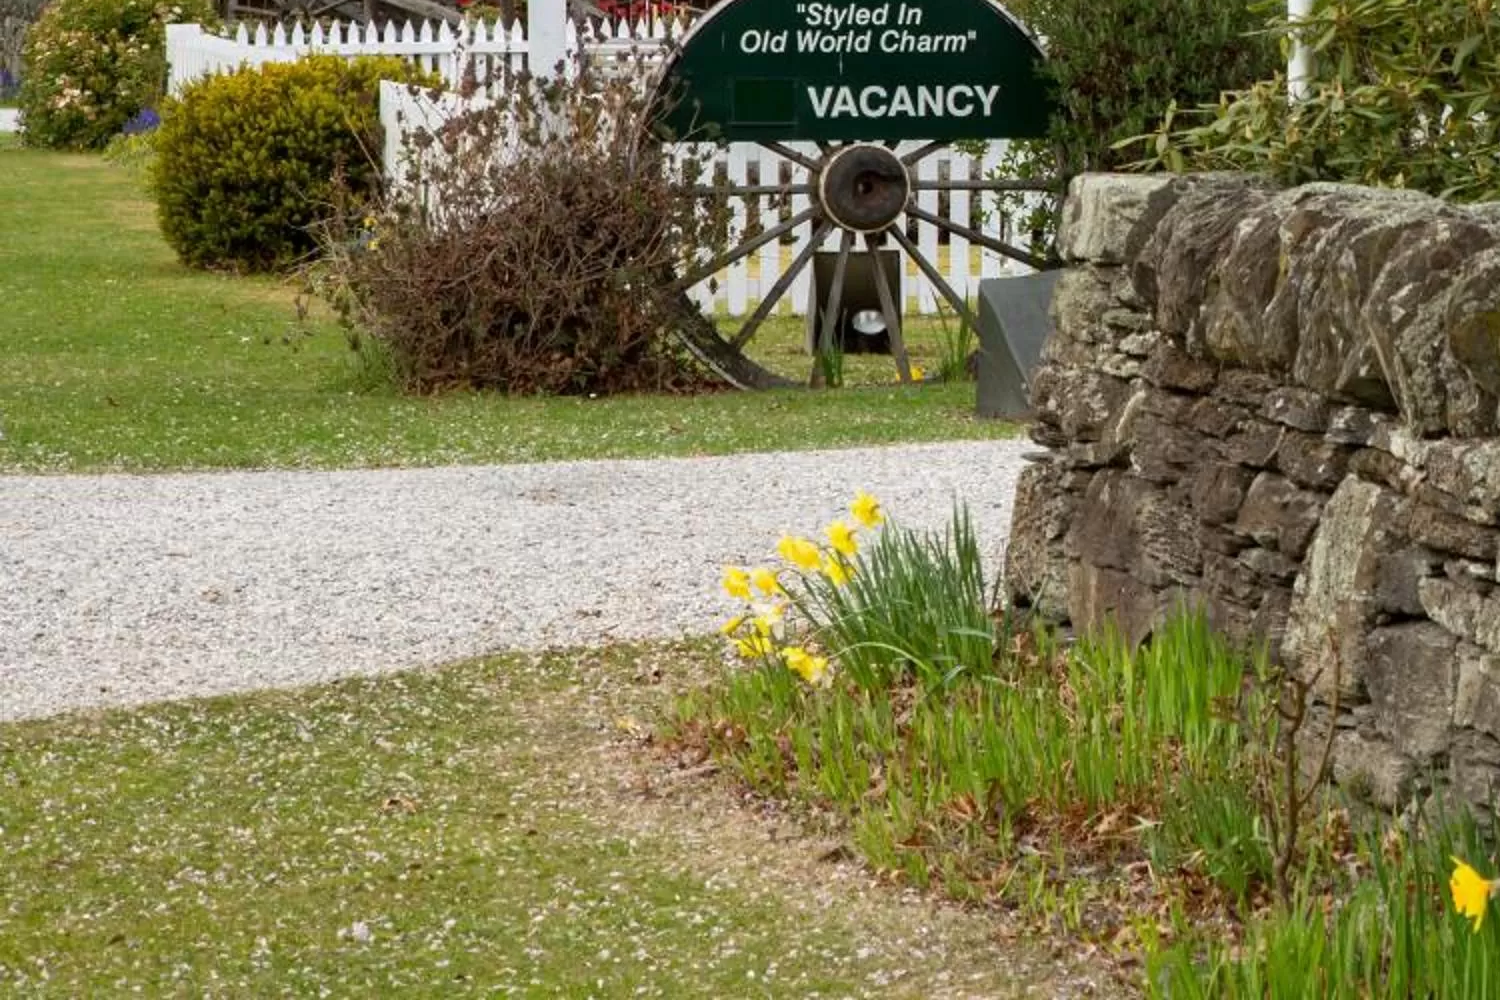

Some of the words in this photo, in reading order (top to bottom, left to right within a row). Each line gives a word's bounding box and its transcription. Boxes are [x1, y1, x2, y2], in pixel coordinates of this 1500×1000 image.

[797, 3, 887, 31] "Styled
[898, 4, 922, 25] In
[740, 31, 786, 53] Old
[797, 31, 870, 53] World
[880, 31, 976, 53] Charm"
[808, 86, 999, 118] VACANCY
